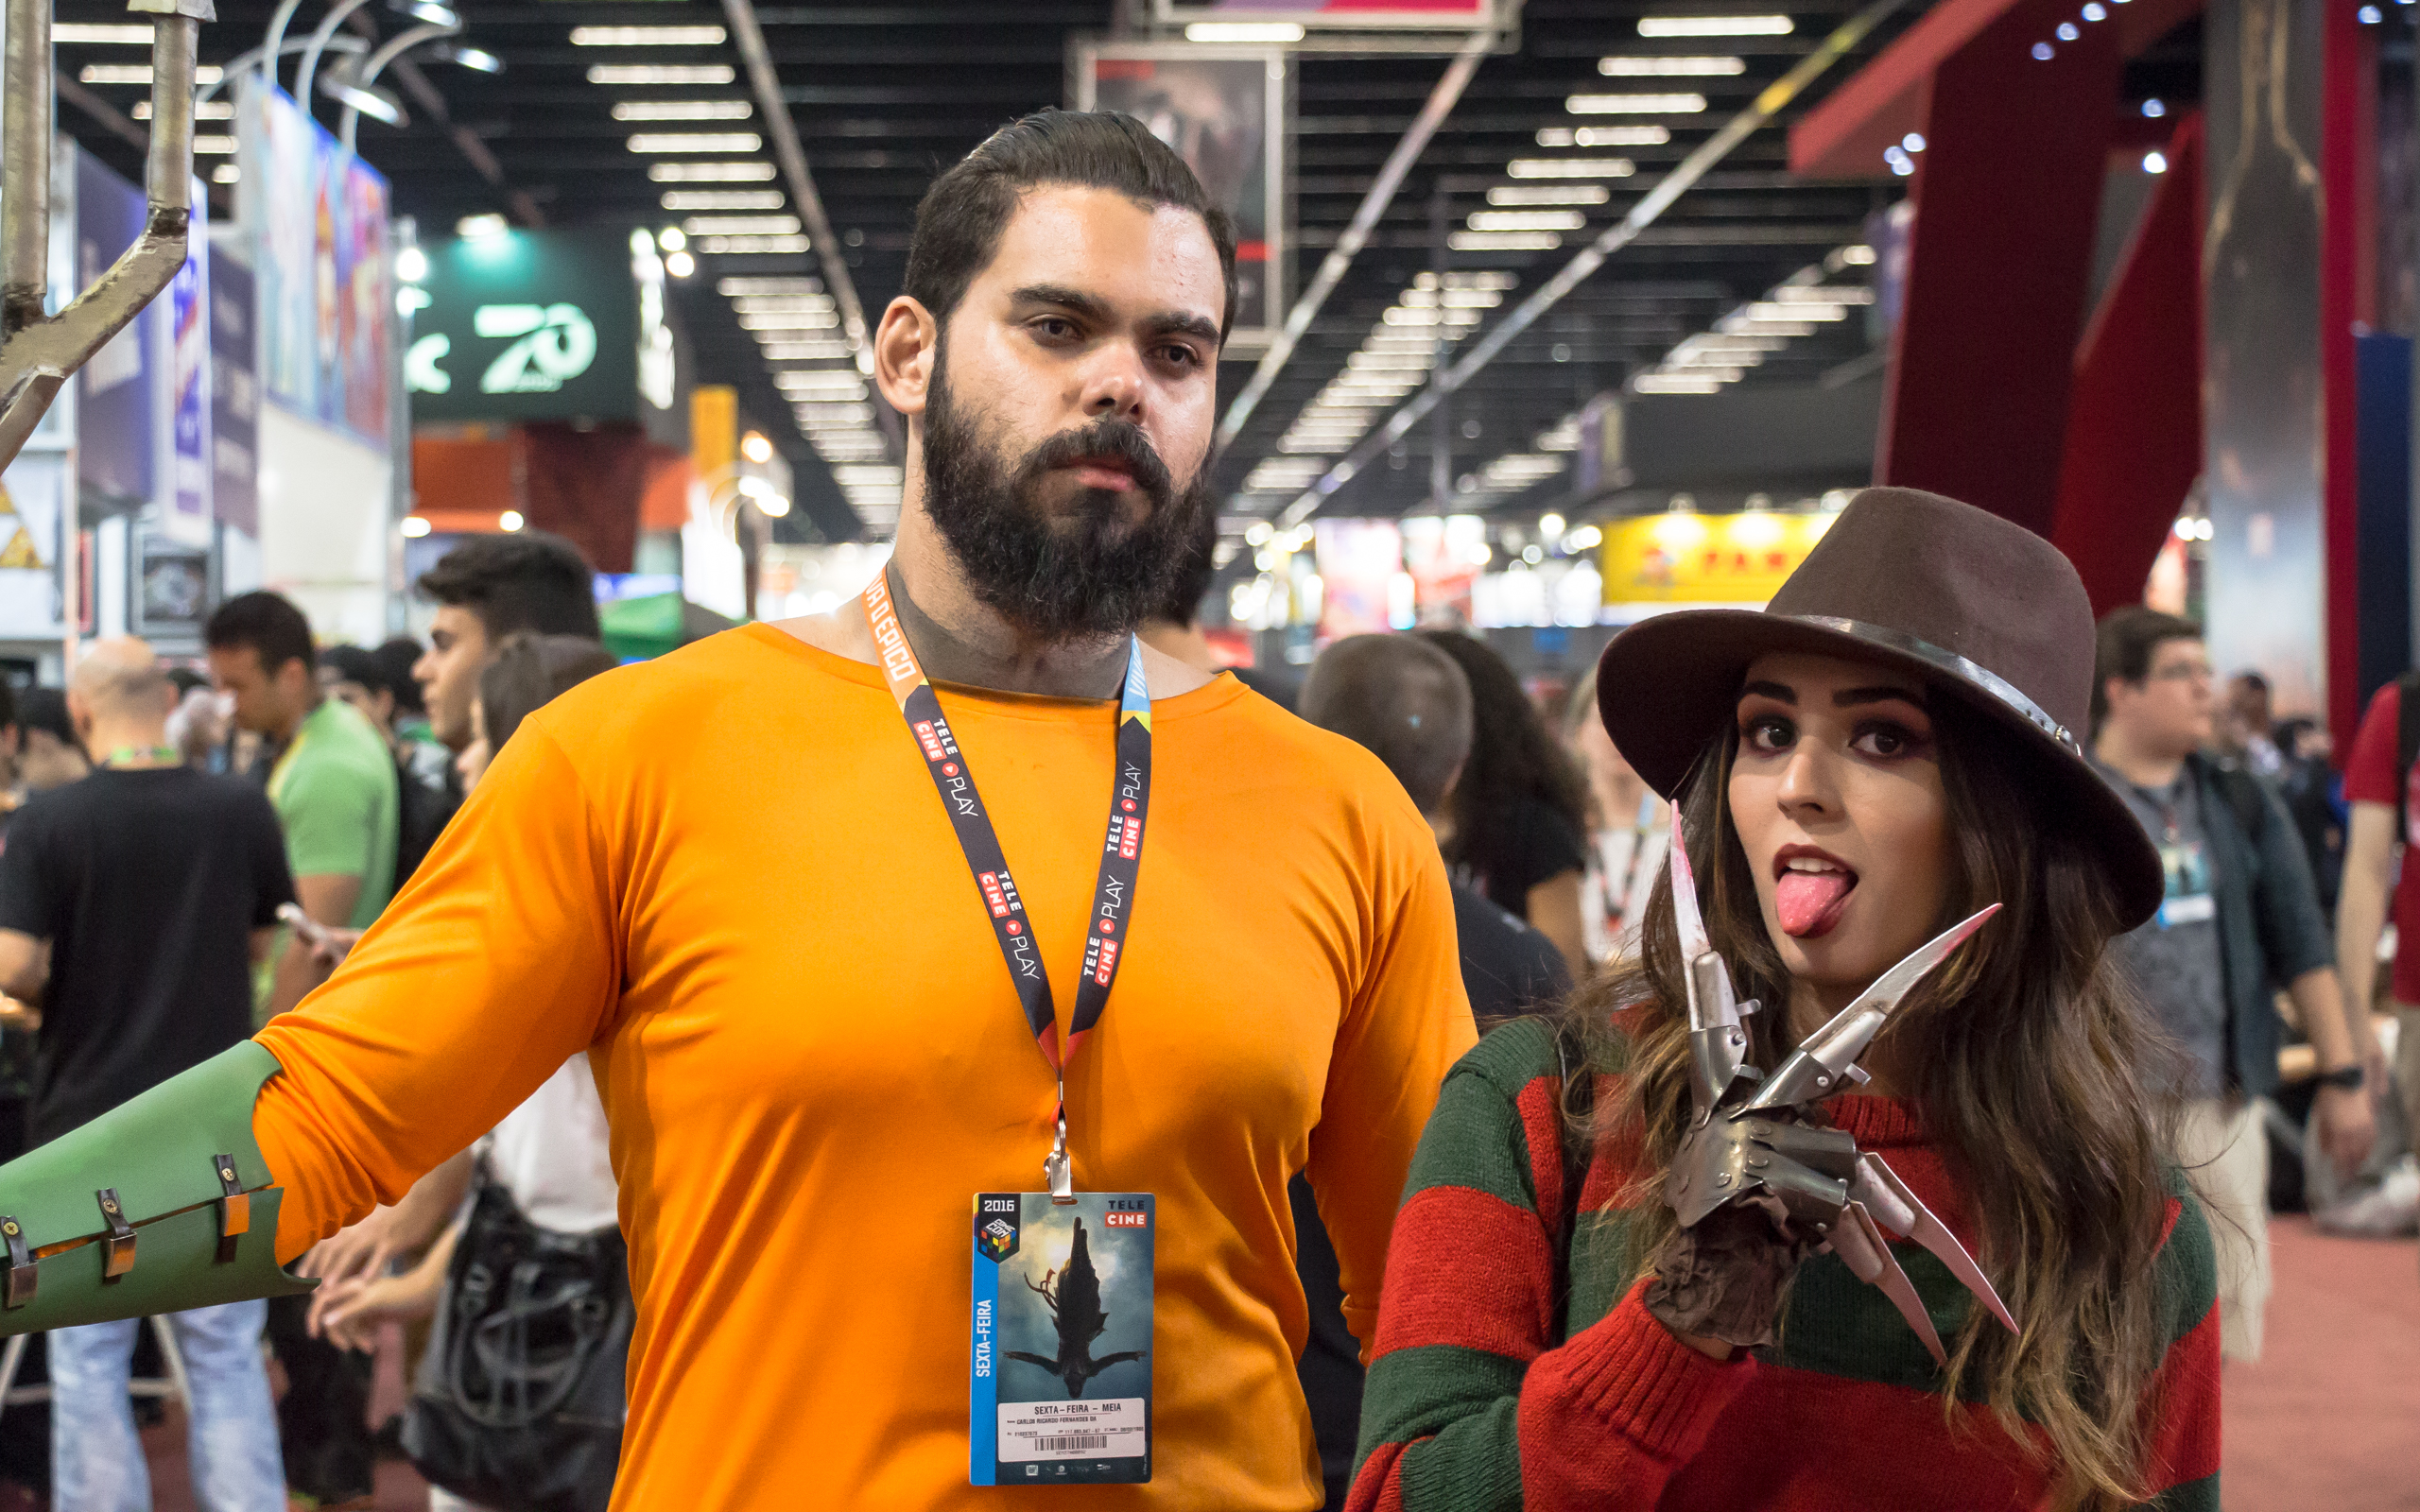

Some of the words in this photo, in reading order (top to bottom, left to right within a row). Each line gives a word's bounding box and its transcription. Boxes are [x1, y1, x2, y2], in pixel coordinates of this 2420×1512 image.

[475, 302, 597, 393] 70
[874, 615, 917, 682] ÉPICO
[933, 718, 958, 756] TELE
[916, 722, 943, 760] CINE
[946, 776, 978, 817] PLAY
[1123, 762, 1141, 799] PLAY
[1106, 815, 1123, 851] TELE
[1122, 818, 1139, 857] CINE
[997, 870, 1022, 912] TELE
[1101, 875, 1124, 919] PLAY
[982, 874, 1007, 916] CINE
[1010, 936, 1040, 979] PLAY
[1084, 936, 1100, 975] TELE
[1098, 941, 1116, 984] CINE
[984, 1200, 1015, 1212] 2016
[1107, 1214, 1145, 1225] CINE
[1108, 1200, 1145, 1210] TELE
[985, 1222, 1010, 1238] CON
[976, 1299, 992, 1378] SEXTA-FEIRA
[1102, 1403, 1122, 1412] MEIA
